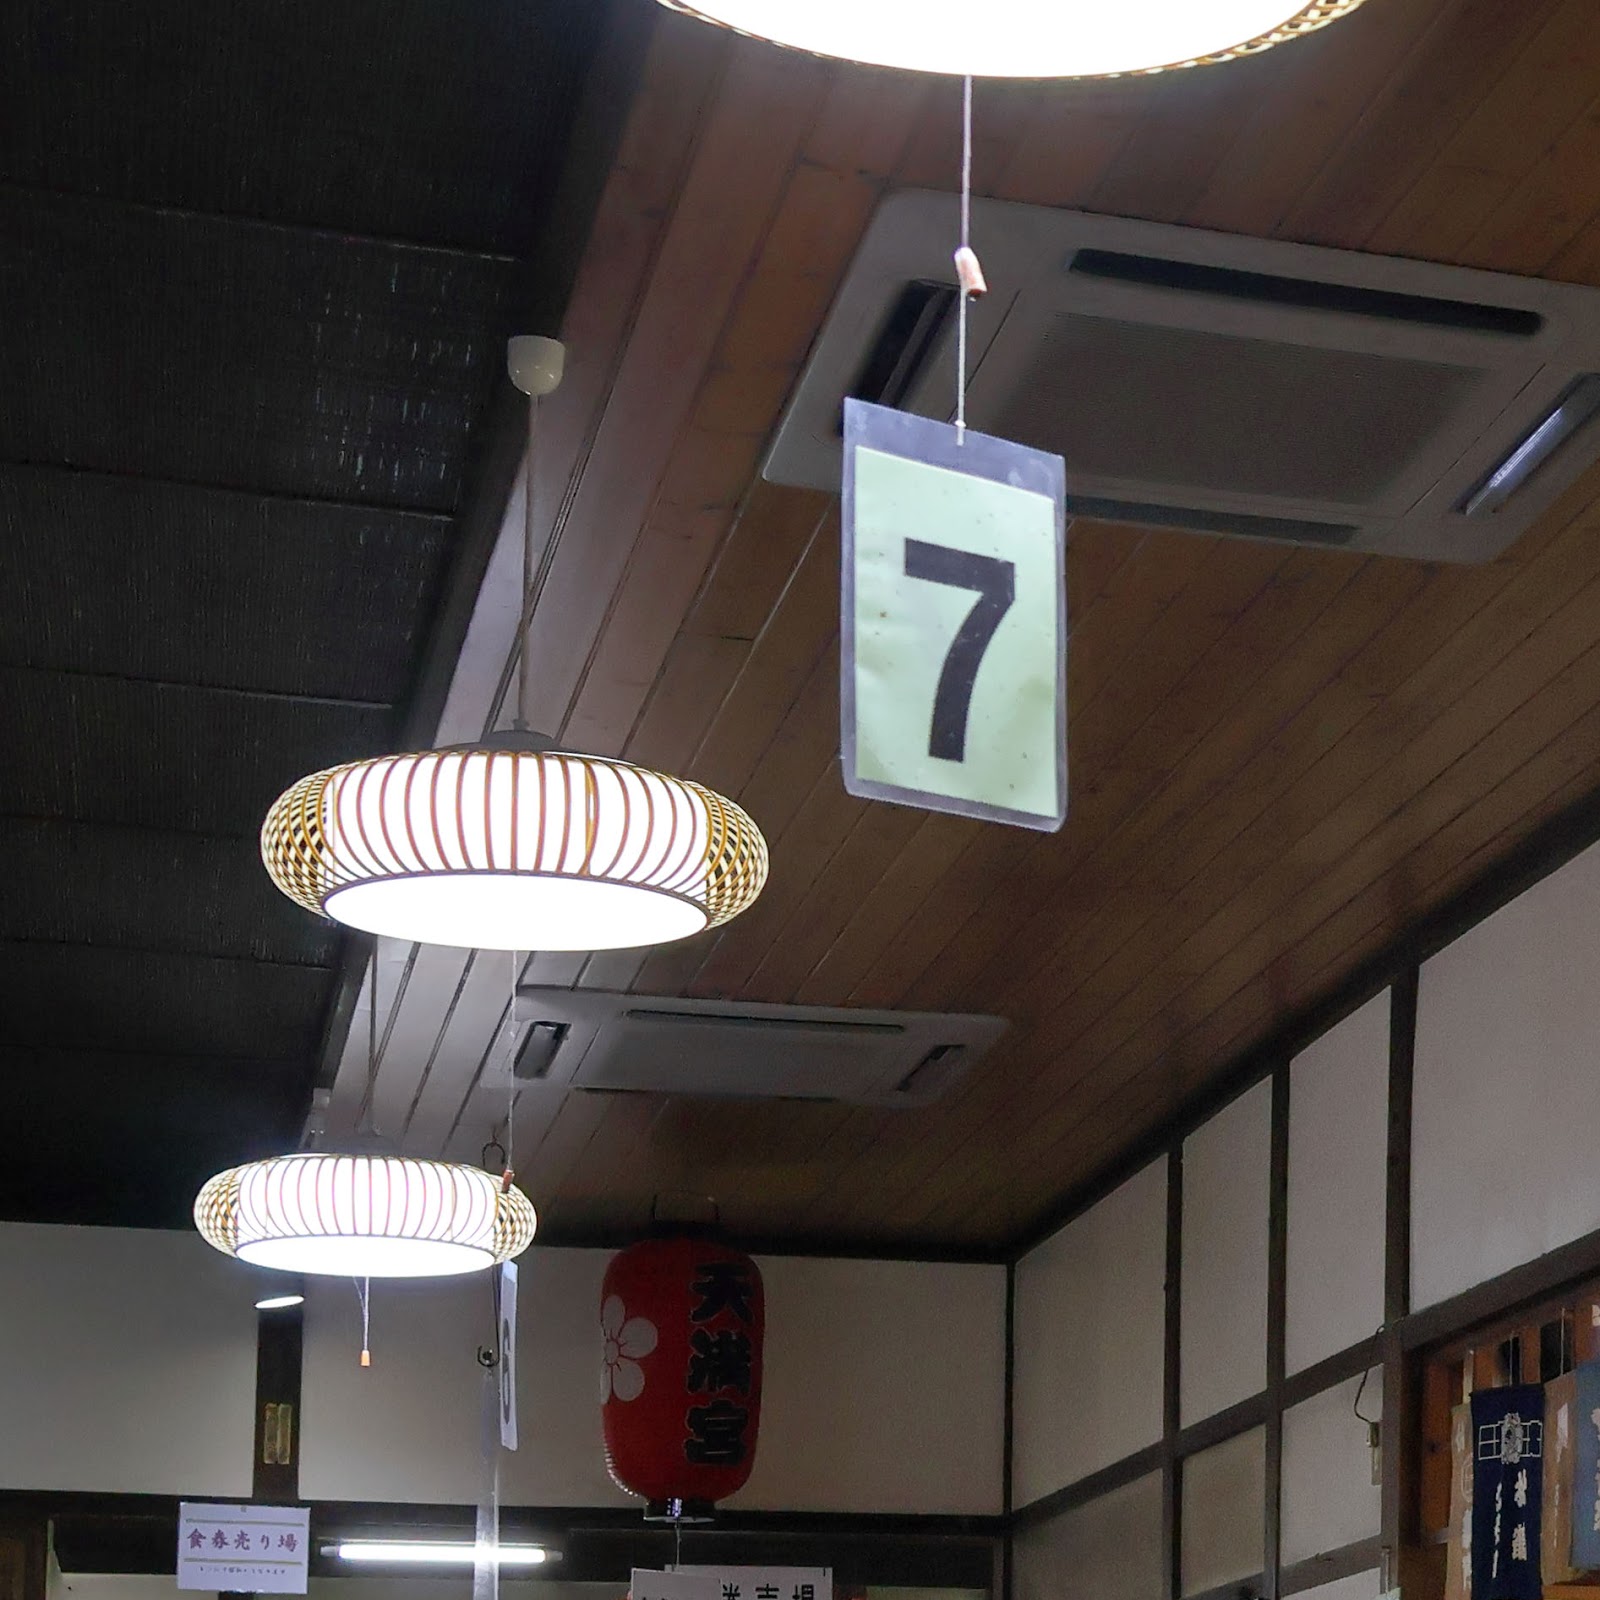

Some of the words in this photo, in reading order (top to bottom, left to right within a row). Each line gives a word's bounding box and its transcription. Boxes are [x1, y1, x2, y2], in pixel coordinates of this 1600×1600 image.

[903, 537, 1015, 763] 7
[685, 1263, 754, 1465] 天満宮
[187, 1527, 299, 1553] 食券売り場
